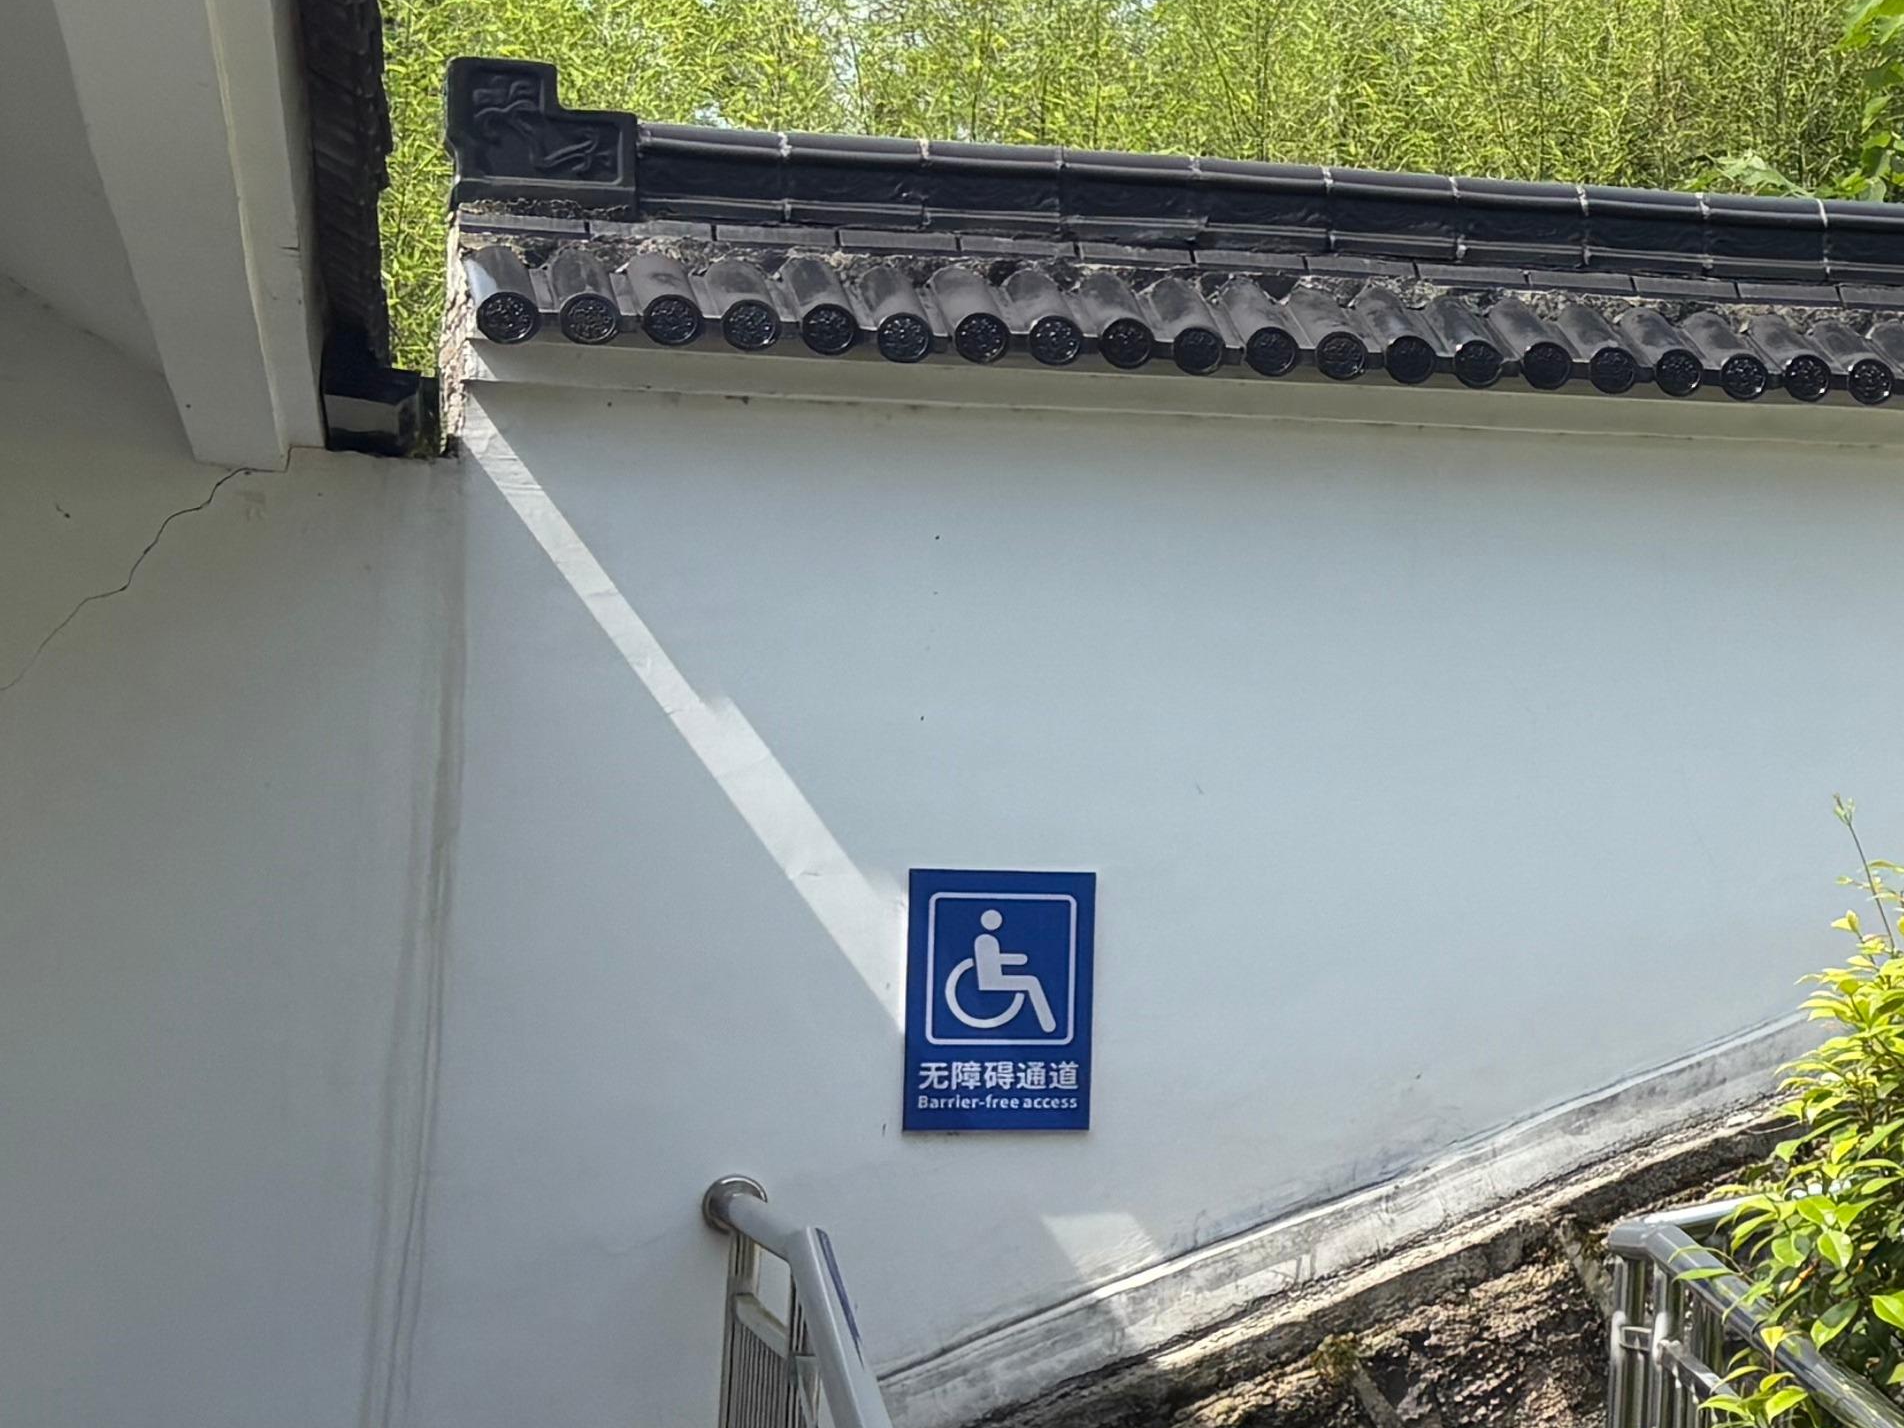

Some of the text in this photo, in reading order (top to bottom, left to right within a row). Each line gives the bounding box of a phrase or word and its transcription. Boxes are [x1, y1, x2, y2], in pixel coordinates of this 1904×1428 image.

[918, 1060, 1079, 1090] 无障碍通道
[917, 1093, 1078, 1109] Barrier-free access
